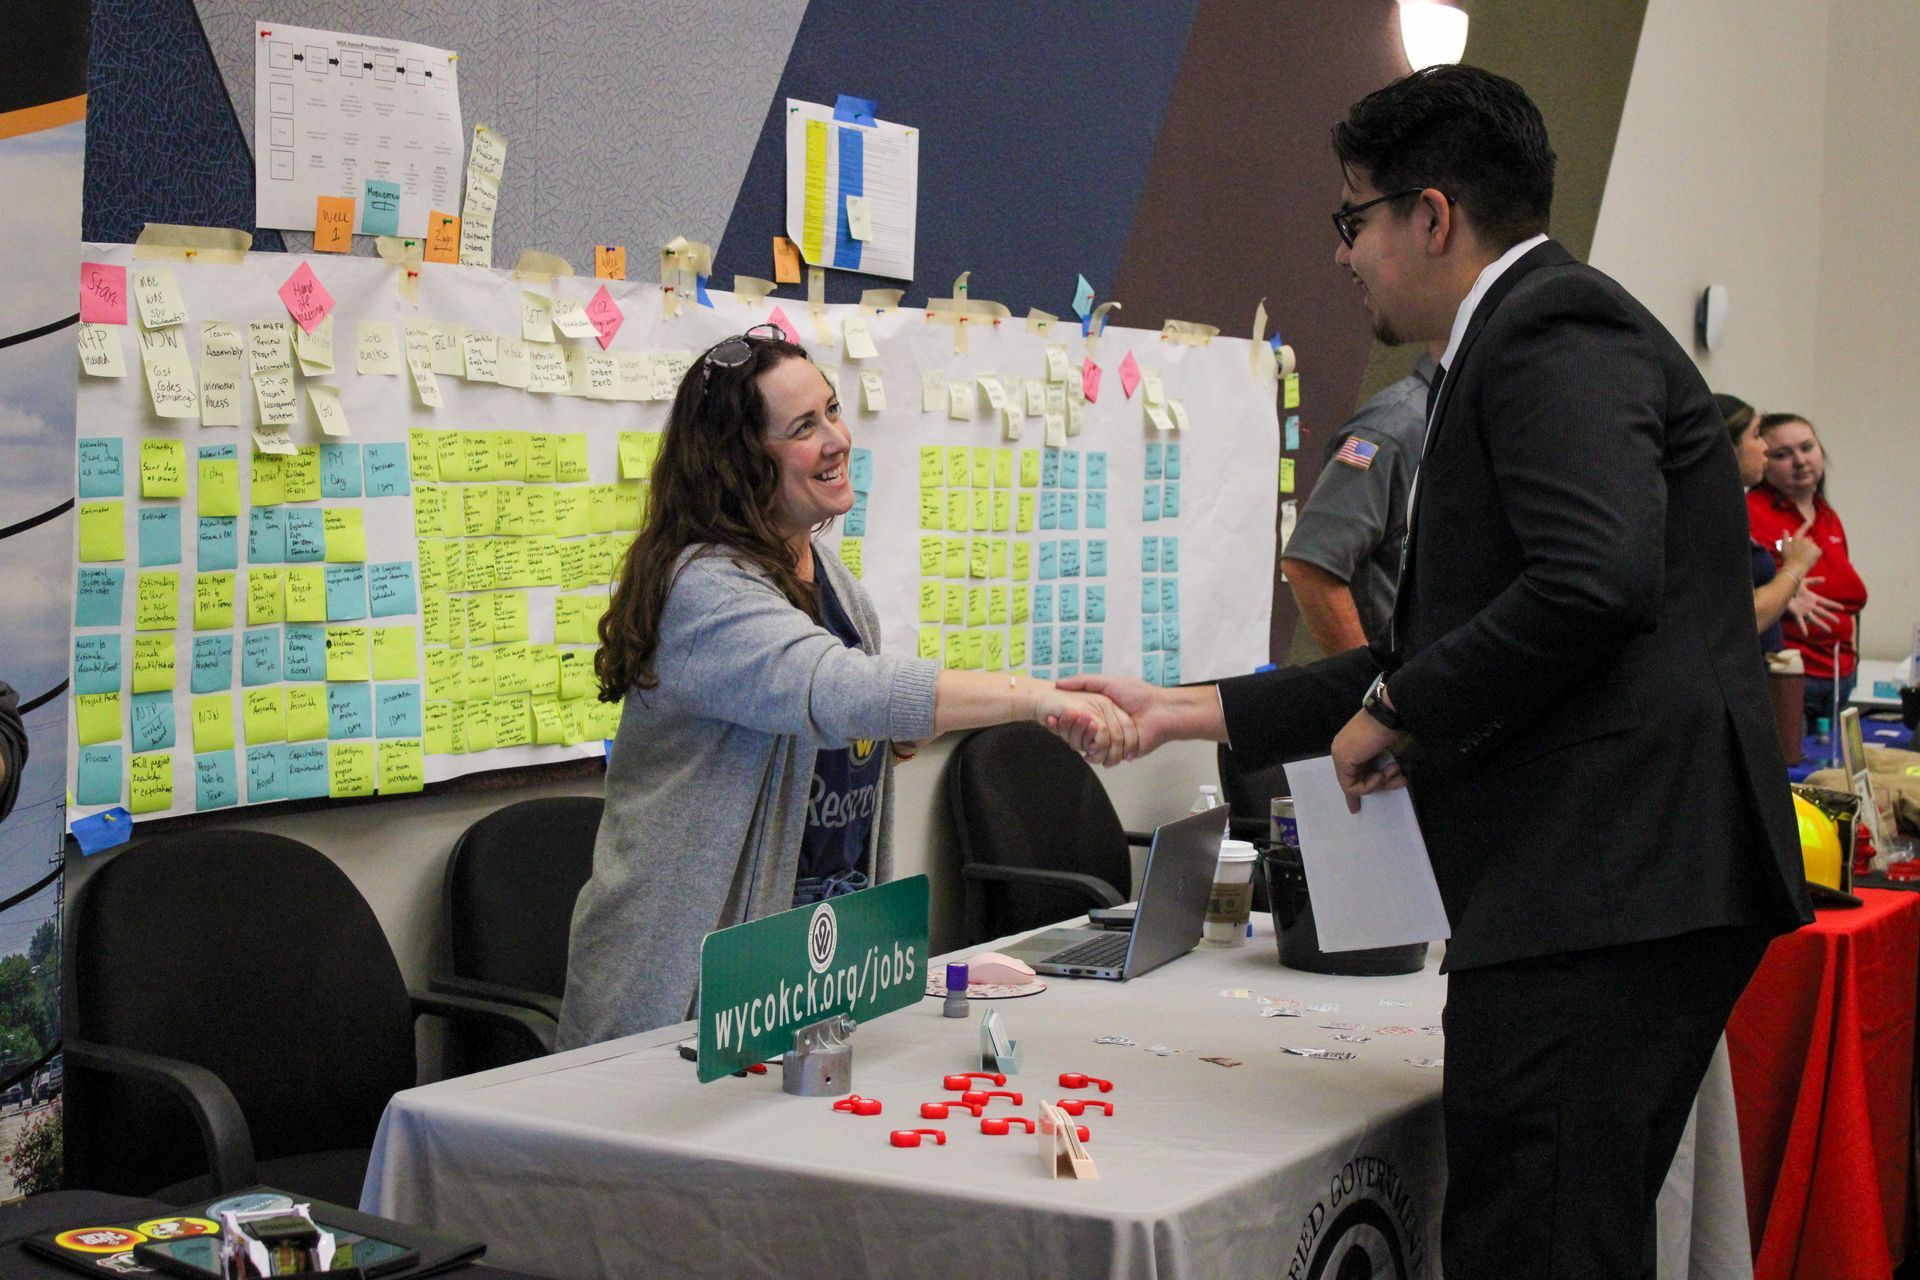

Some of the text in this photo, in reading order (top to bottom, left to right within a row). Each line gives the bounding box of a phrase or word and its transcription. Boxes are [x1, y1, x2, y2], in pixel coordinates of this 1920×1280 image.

[87, 271, 119, 307] Start
[203, 324, 234, 339] Team
[254, 334, 280, 347] Review
[206, 344, 243, 361] Assembly
[156, 379, 182, 394] Codes
[138, 577, 175, 591] Estimating
[715, 941, 915, 1053] wycokck.org/jobs
